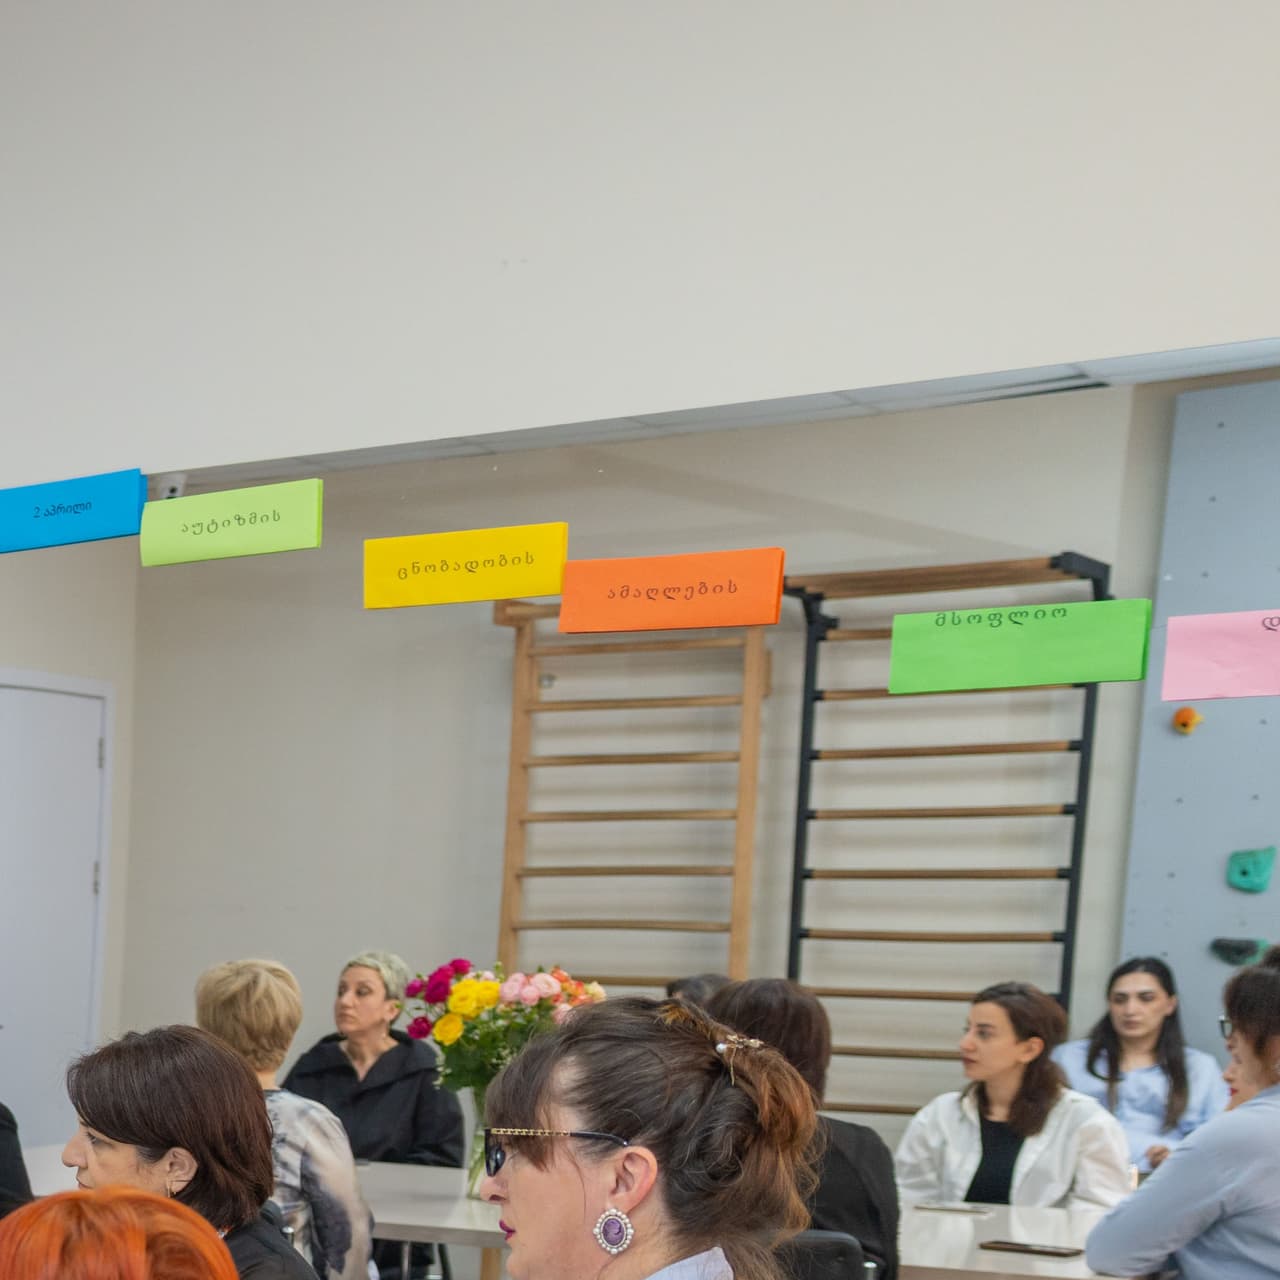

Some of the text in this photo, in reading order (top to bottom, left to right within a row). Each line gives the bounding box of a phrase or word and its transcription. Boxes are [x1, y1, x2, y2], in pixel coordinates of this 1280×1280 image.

[33, 501, 92, 519] 2 აპრილი
[181, 509, 281, 536] აუტიზმის
[397, 551, 535, 581] ცნობადობის
[607, 579, 738, 601] ამაღლების
[934, 606, 1068, 628] მსოფლიო
